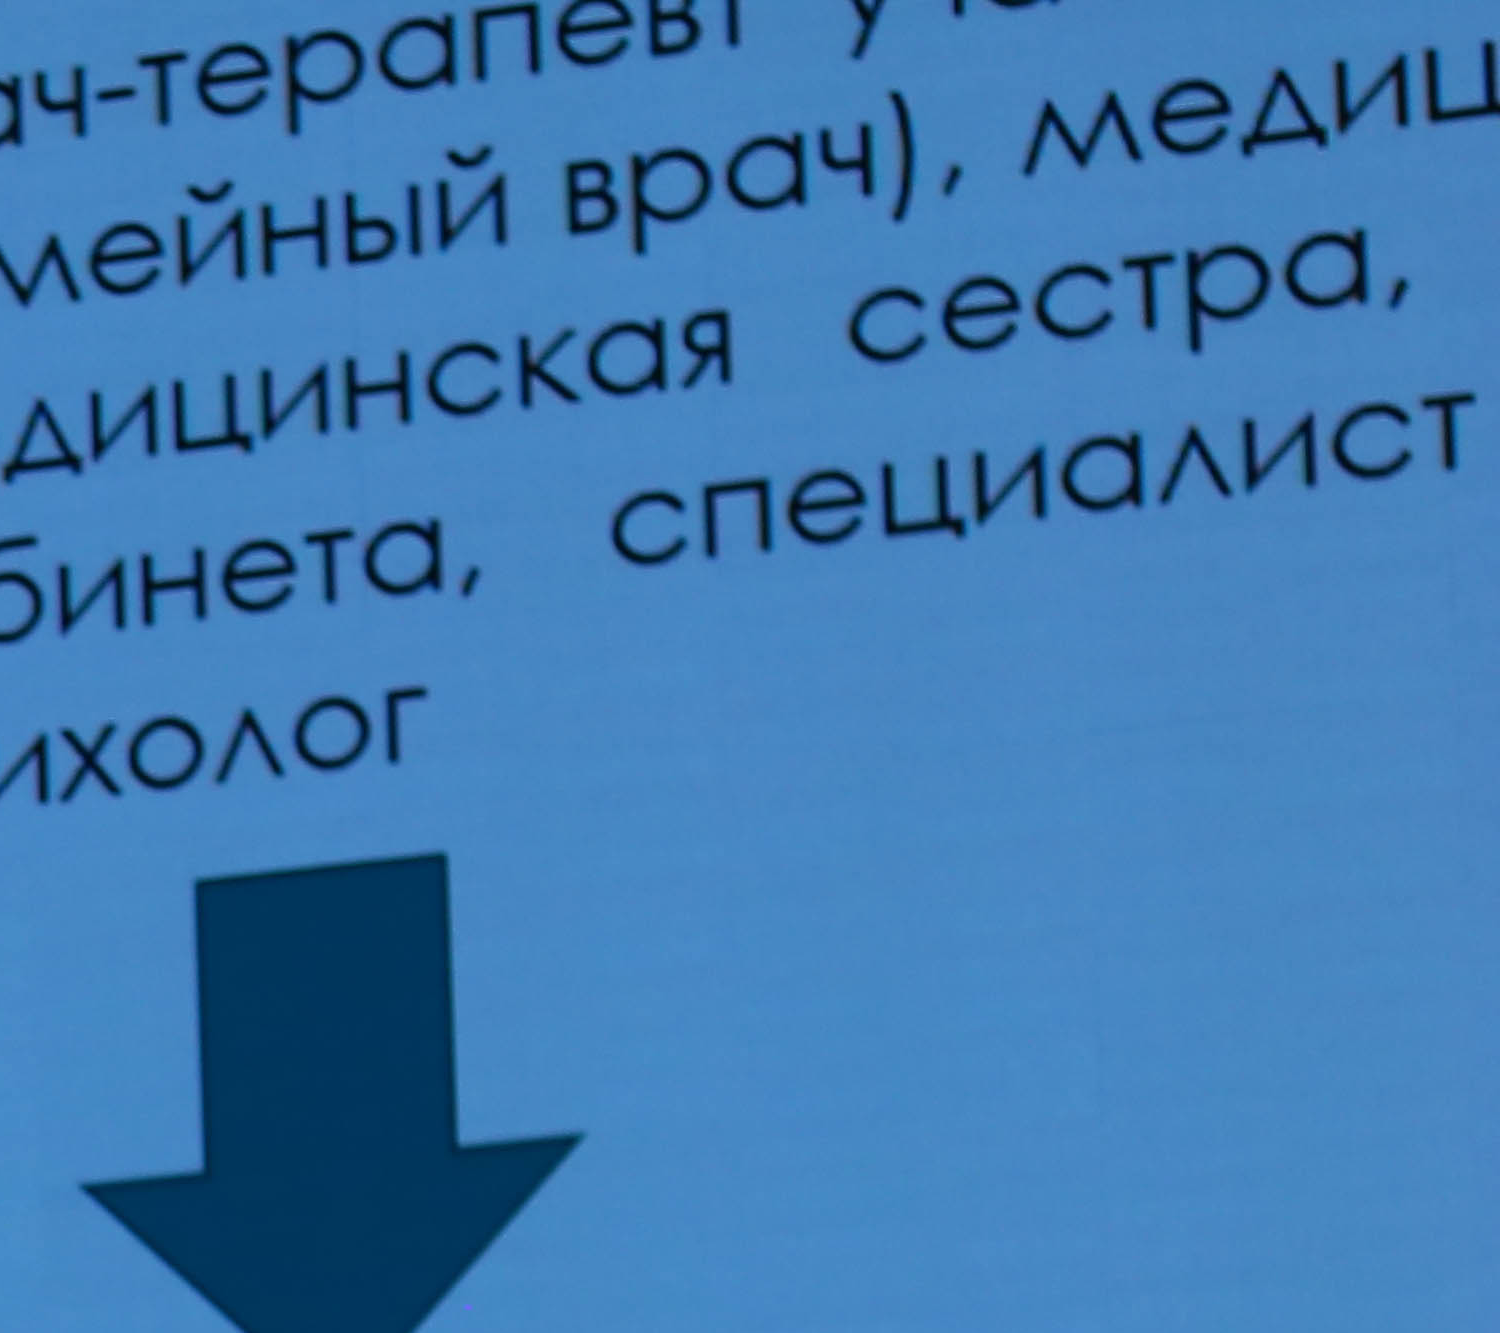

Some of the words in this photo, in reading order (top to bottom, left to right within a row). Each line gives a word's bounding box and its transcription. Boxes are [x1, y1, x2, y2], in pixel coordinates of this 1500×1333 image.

[564, 90, 962, 255] врач),
[847, 228, 1408, 363] сестра,
[612, 392, 1476, 566] специалист
